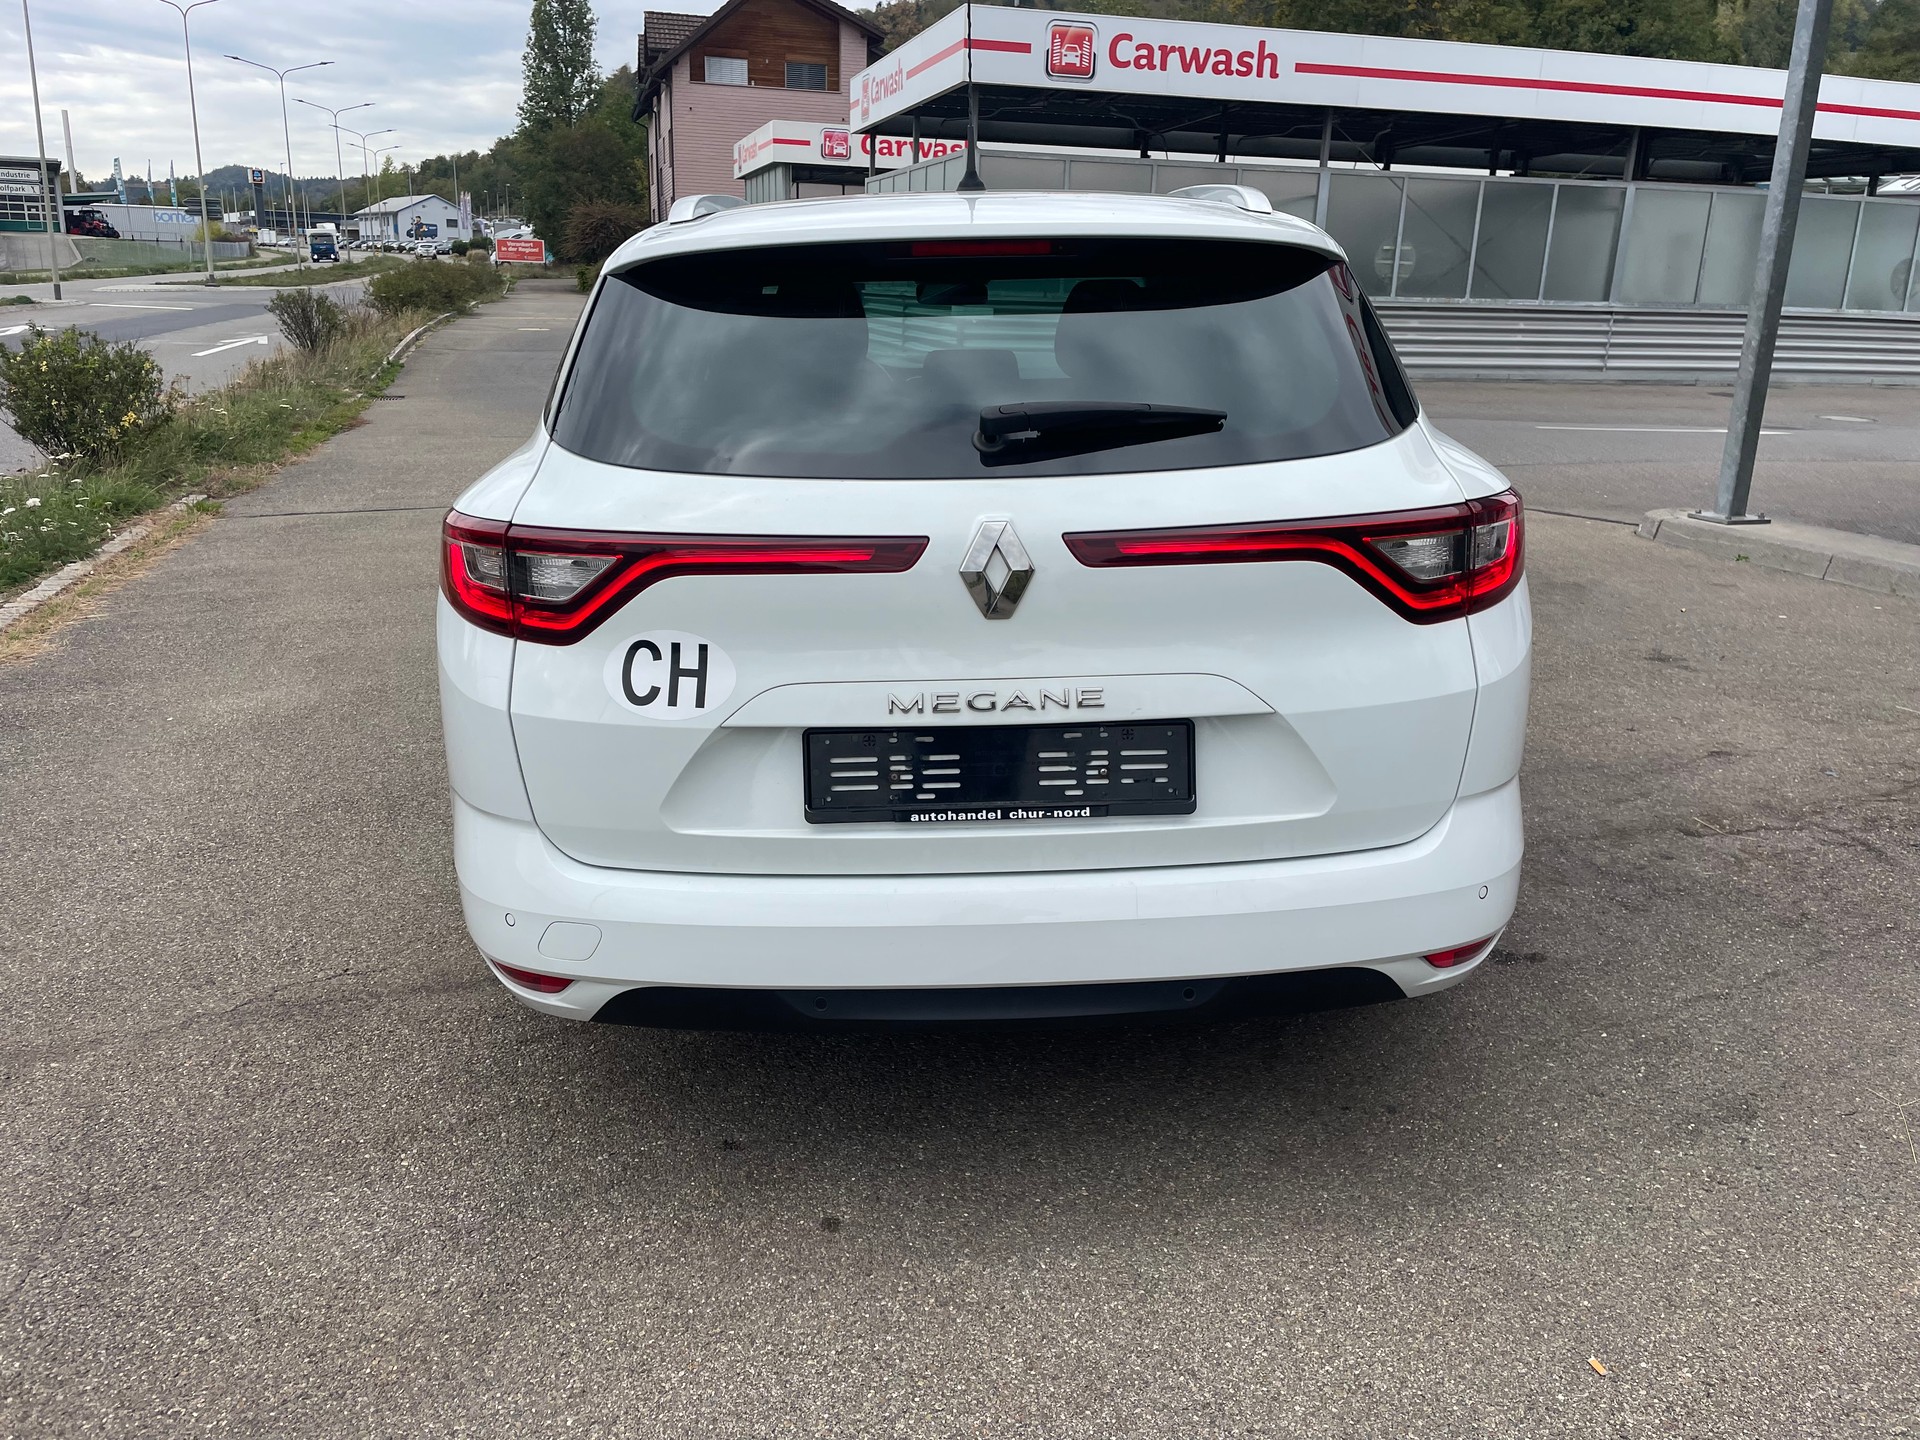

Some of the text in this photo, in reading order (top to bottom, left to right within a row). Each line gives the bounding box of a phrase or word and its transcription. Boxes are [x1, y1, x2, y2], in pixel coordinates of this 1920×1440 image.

[1108, 33, 1279, 79] Carwash
[871, 58, 903, 104] Carwash
[861, 134, 969, 159] Carwas
[1, 171, 31, 179] ndustrie
[0, 185, 26, 193] olfpark
[622, 639, 708, 708] CH
[888, 687, 1105, 714] MEGANE
[911, 807, 1090, 822] autohandel chur-nord
